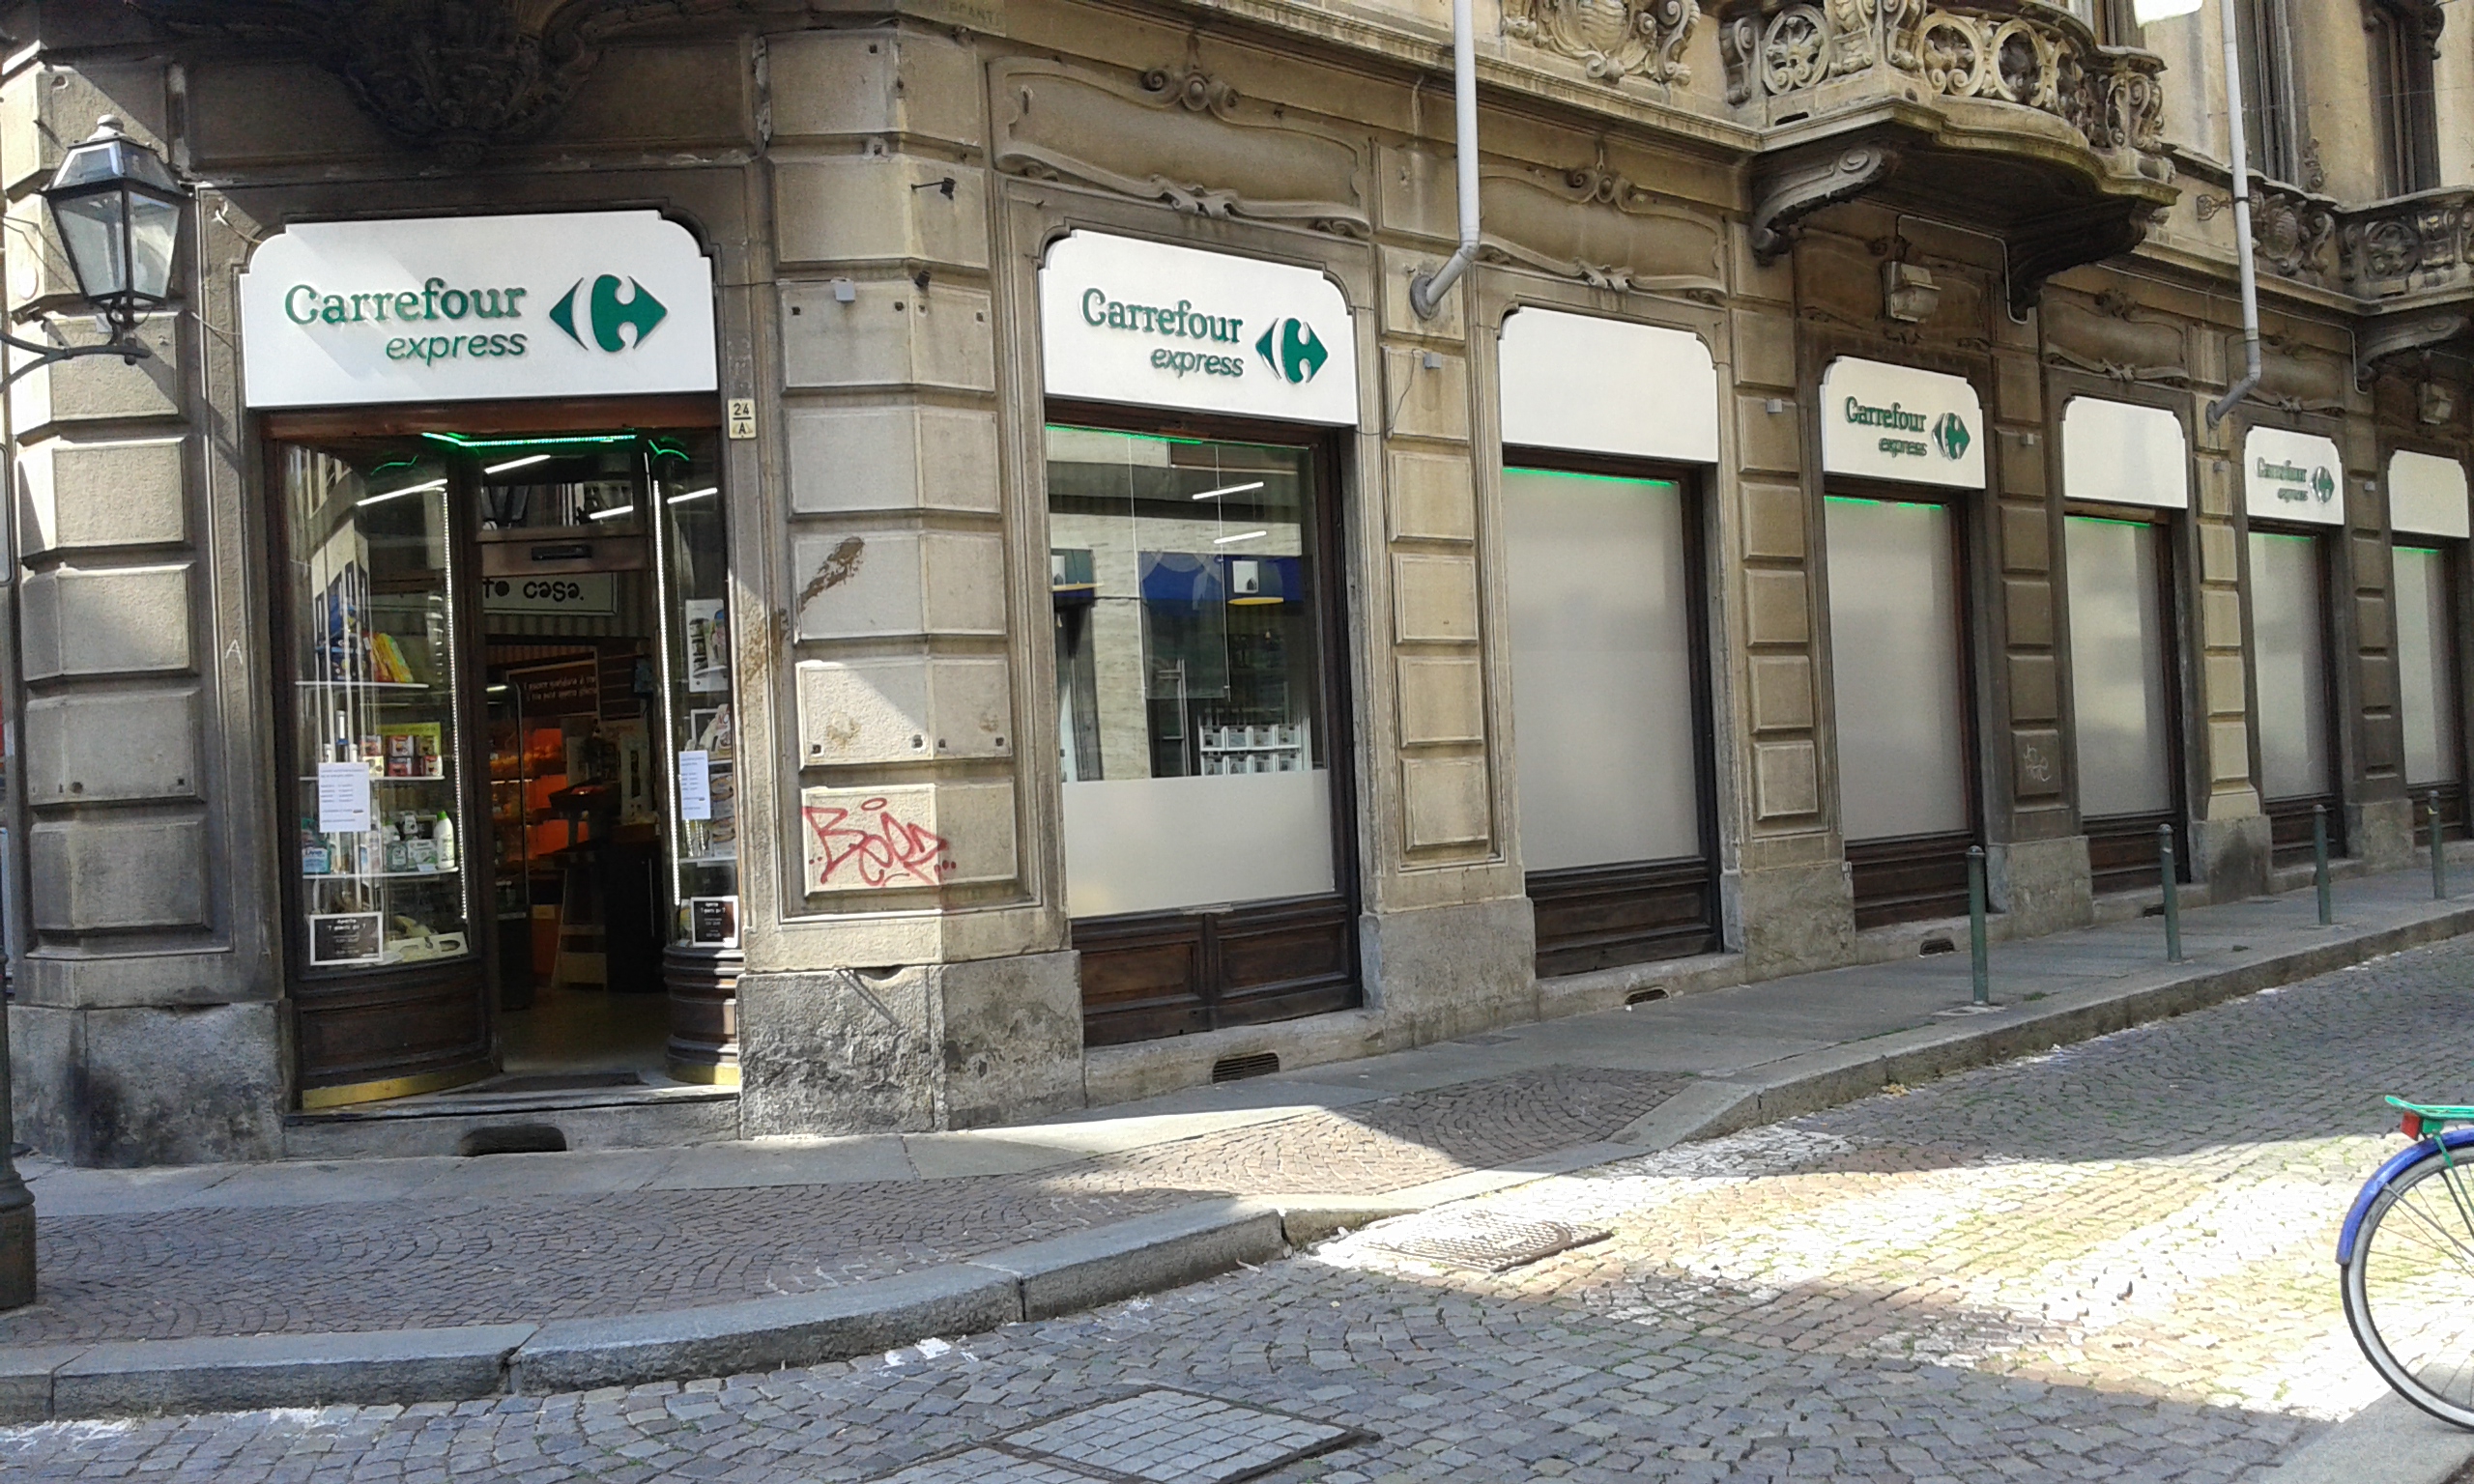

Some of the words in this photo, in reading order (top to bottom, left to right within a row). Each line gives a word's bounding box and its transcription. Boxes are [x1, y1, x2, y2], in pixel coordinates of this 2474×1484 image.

[285, 276, 528, 325] Carrefour
[1081, 287, 1244, 344] Carrefour
[386, 333, 529, 367] express
[1150, 348, 1245, 379] express
[733, 402, 750, 415] 24
[1845, 396, 1927, 433] Carrefour
[738, 421, 747, 435] A
[1879, 438, 1928, 458] express
